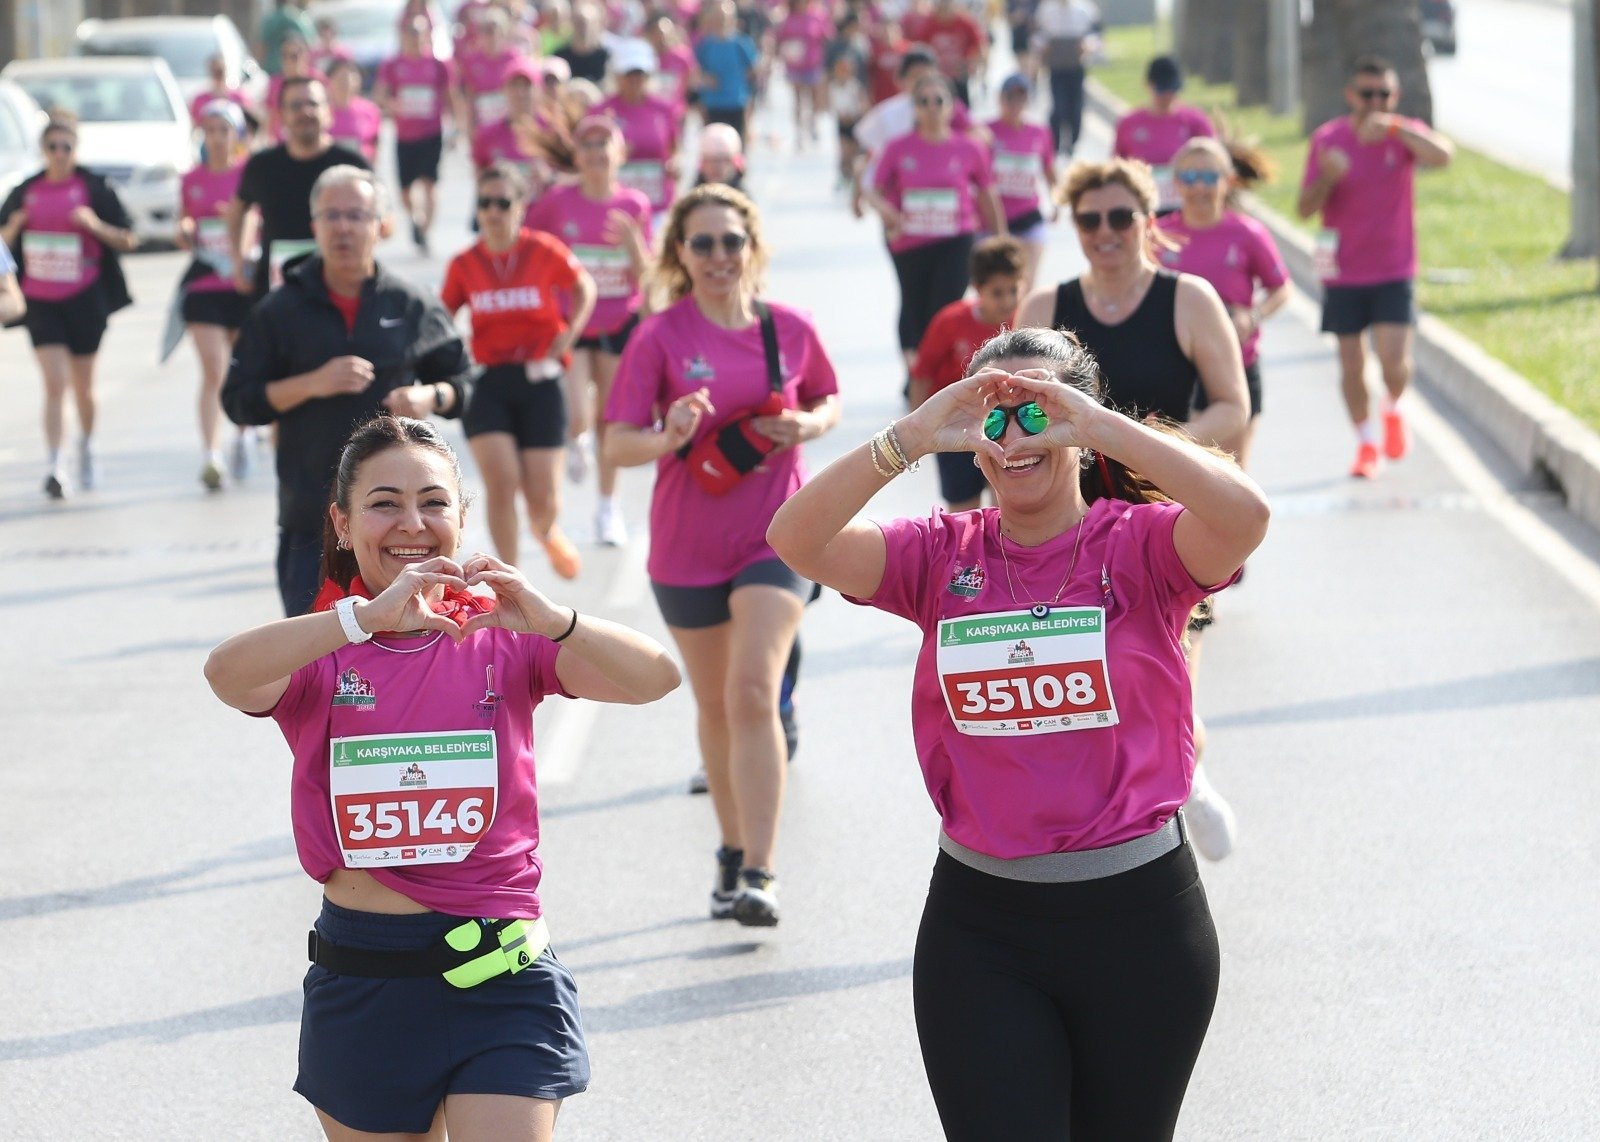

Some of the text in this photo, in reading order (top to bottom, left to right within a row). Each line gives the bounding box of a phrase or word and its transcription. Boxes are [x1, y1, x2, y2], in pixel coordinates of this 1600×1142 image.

[966, 616, 1098, 638] KARŞIYAKA BELEDİYESİ
[956, 672, 1097, 714] 35108
[356, 740, 490, 759] KARŞIYAKA BELEDİYESİ
[346, 797, 485, 842] 35146
